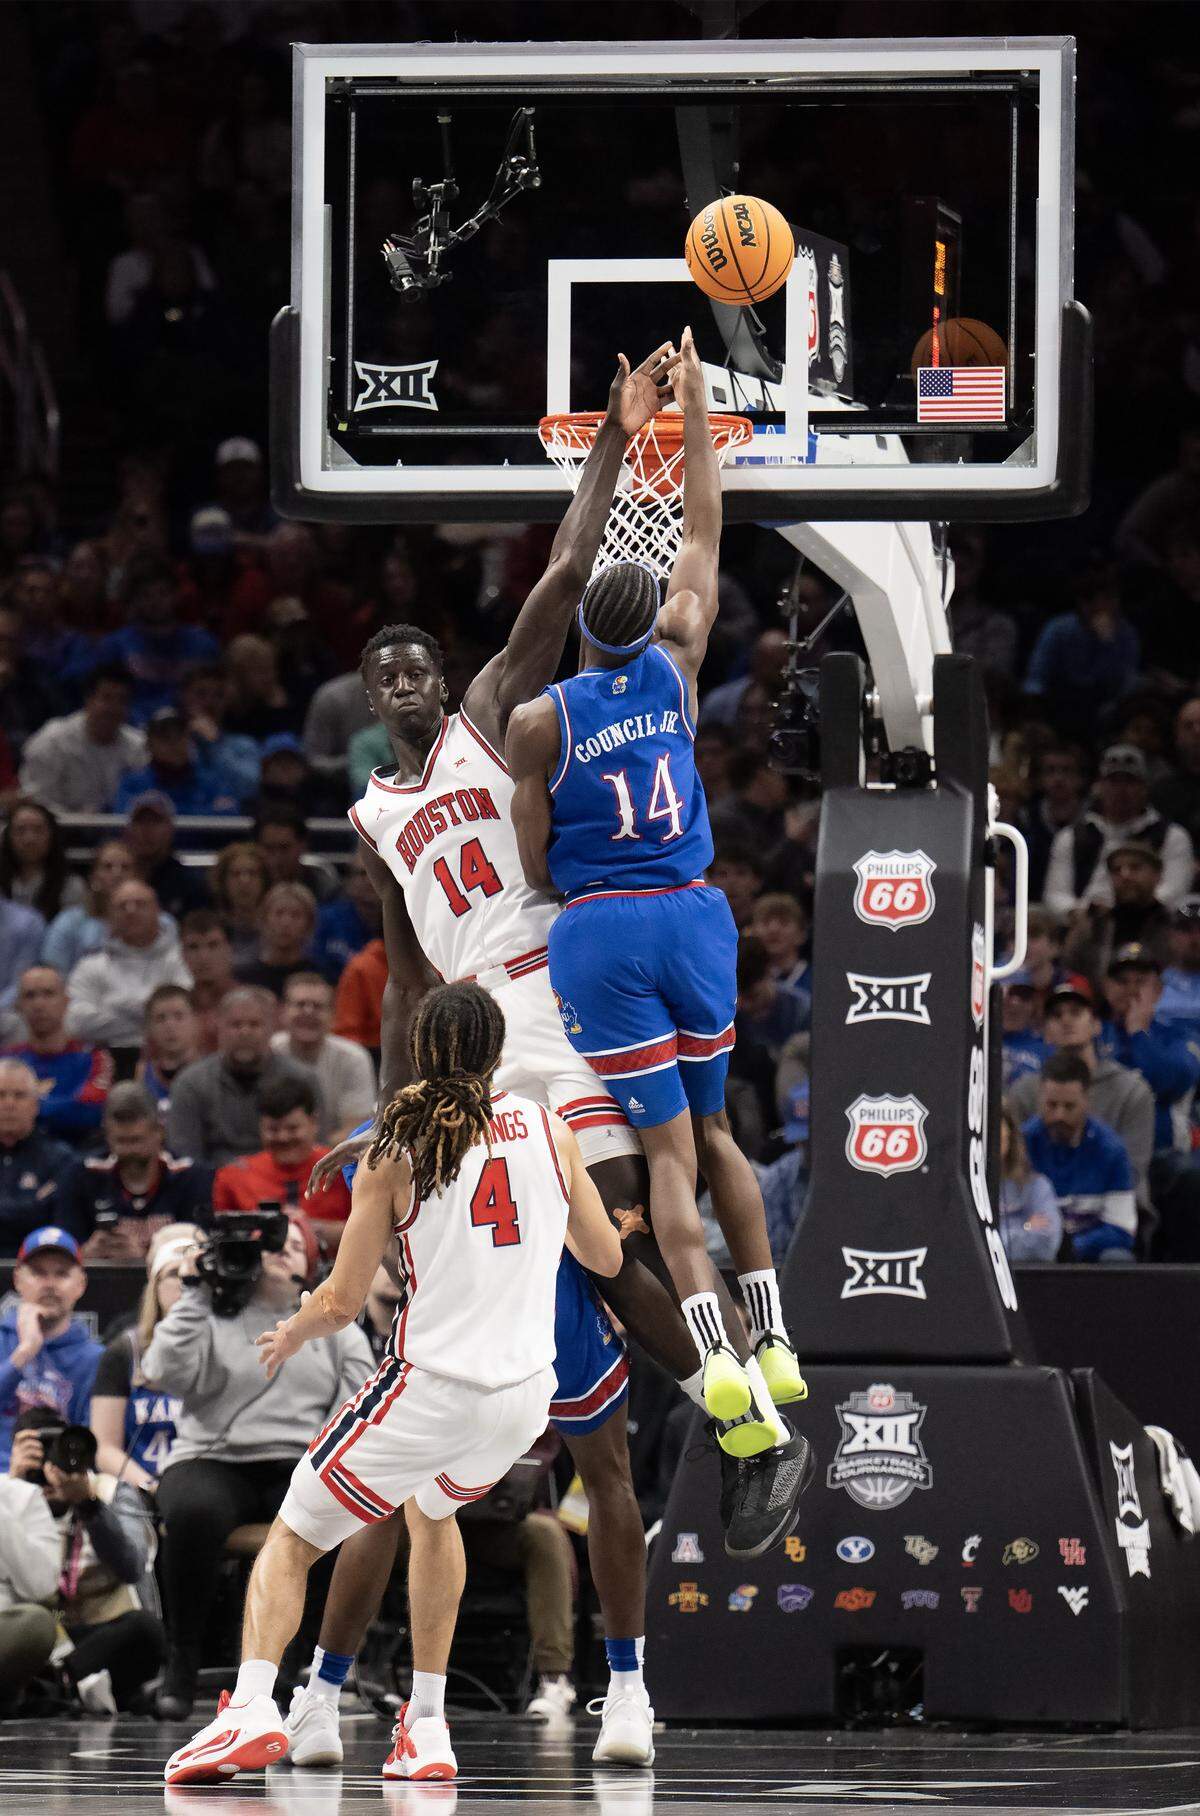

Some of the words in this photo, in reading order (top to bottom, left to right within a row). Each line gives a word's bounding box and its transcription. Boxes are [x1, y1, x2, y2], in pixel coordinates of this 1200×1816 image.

[701, 207, 729, 273] Wilson
[733, 203, 757, 249] NCAA
[355, 361, 438, 411] XII
[575, 713, 656, 763] COUNCIL
[659, 710, 679, 734] JR.
[601, 753, 684, 842] 14
[396, 788, 501, 875] HOUSTON
[433, 837, 504, 918] 14
[866, 863, 923, 875] PHILLIPS
[869, 881, 920, 912] 66
[846, 973, 931, 1024] XII
[859, 1108, 915, 1122] PHILLIPS
[860, 1128, 912, 1158] 66
[470, 1157, 521, 1247] 4
[841, 1247, 927, 1298] XII
[842, 1411, 919, 1455] XII
